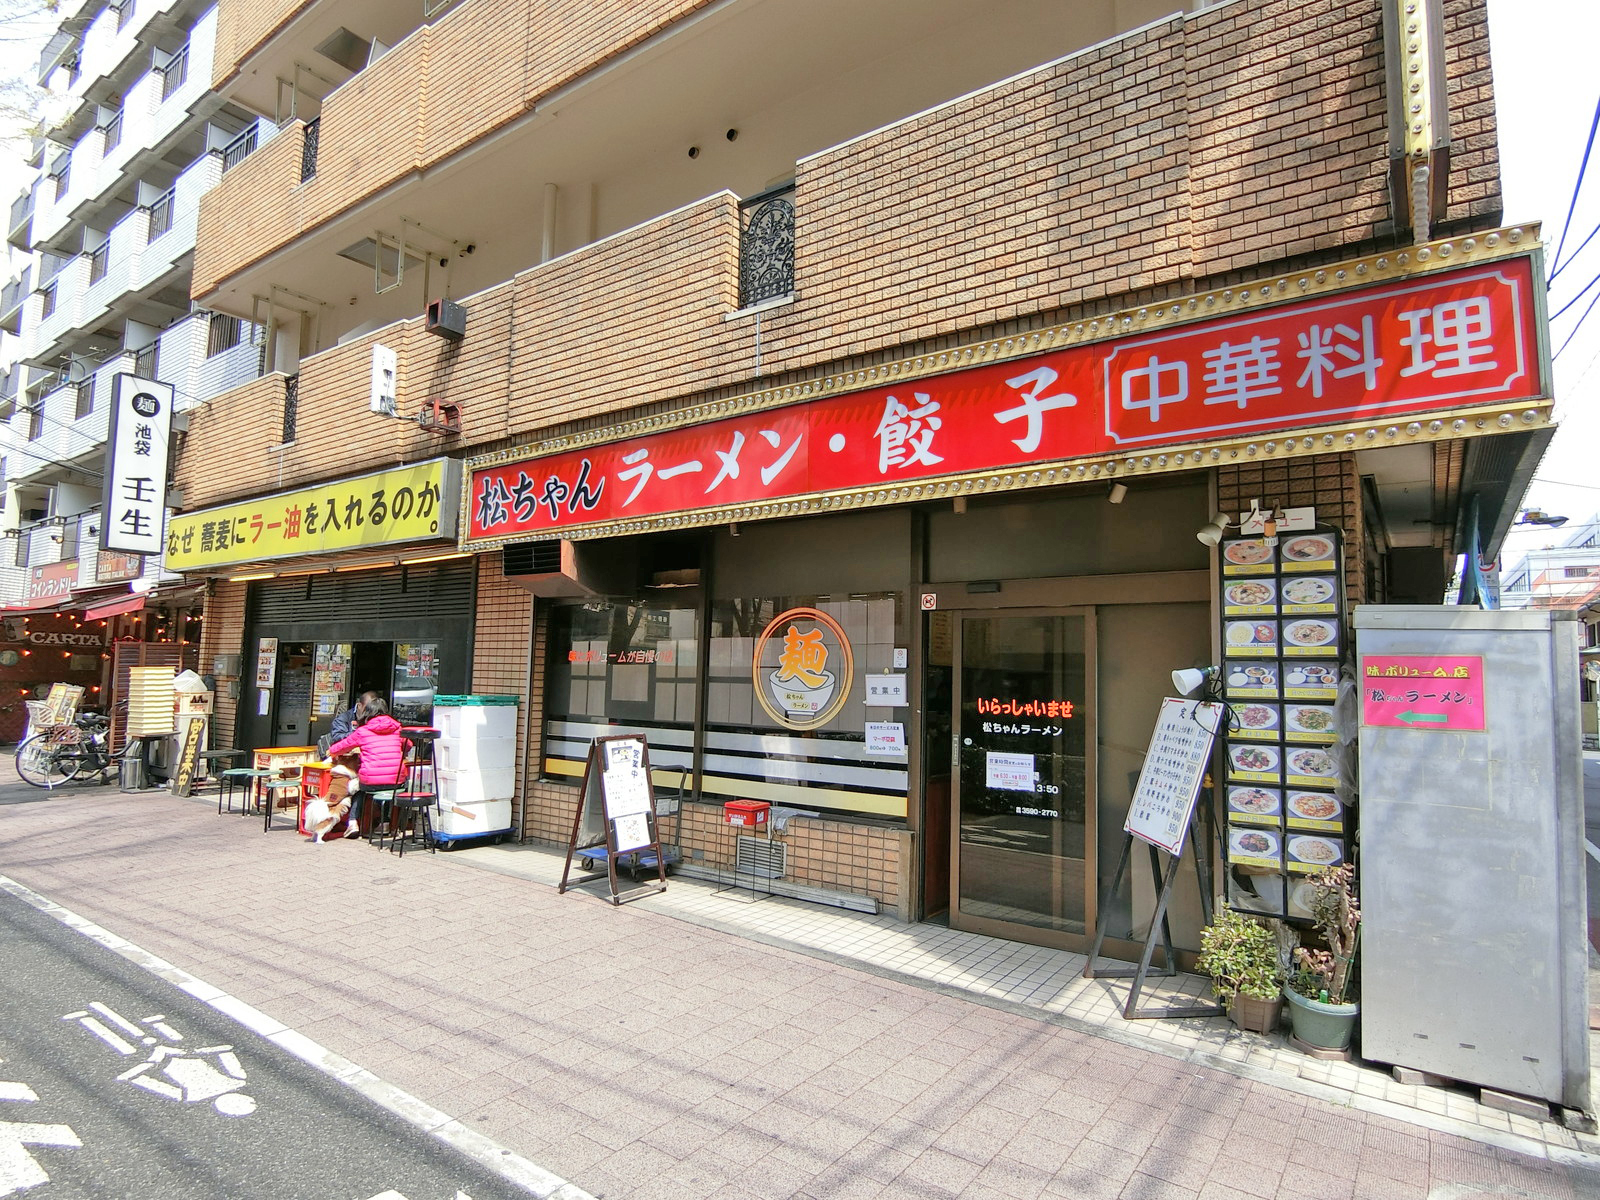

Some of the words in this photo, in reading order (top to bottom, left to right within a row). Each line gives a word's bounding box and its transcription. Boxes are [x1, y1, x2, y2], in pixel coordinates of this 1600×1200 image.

[1121, 295, 1498, 423] 中華料理
[134, 422, 152, 457] 池袋
[119, 477, 157, 537] 壬生
[29, 631, 103, 646] CARTA
[870, 685, 901, 696] 営業中
[977, 697, 1074, 718] いらっしゃいませ
[982, 721, 1063, 736] 松ちゃんラーメン
[178, 718, 204, 795] 営業中
[1036, 784, 1059, 794] 3:50
